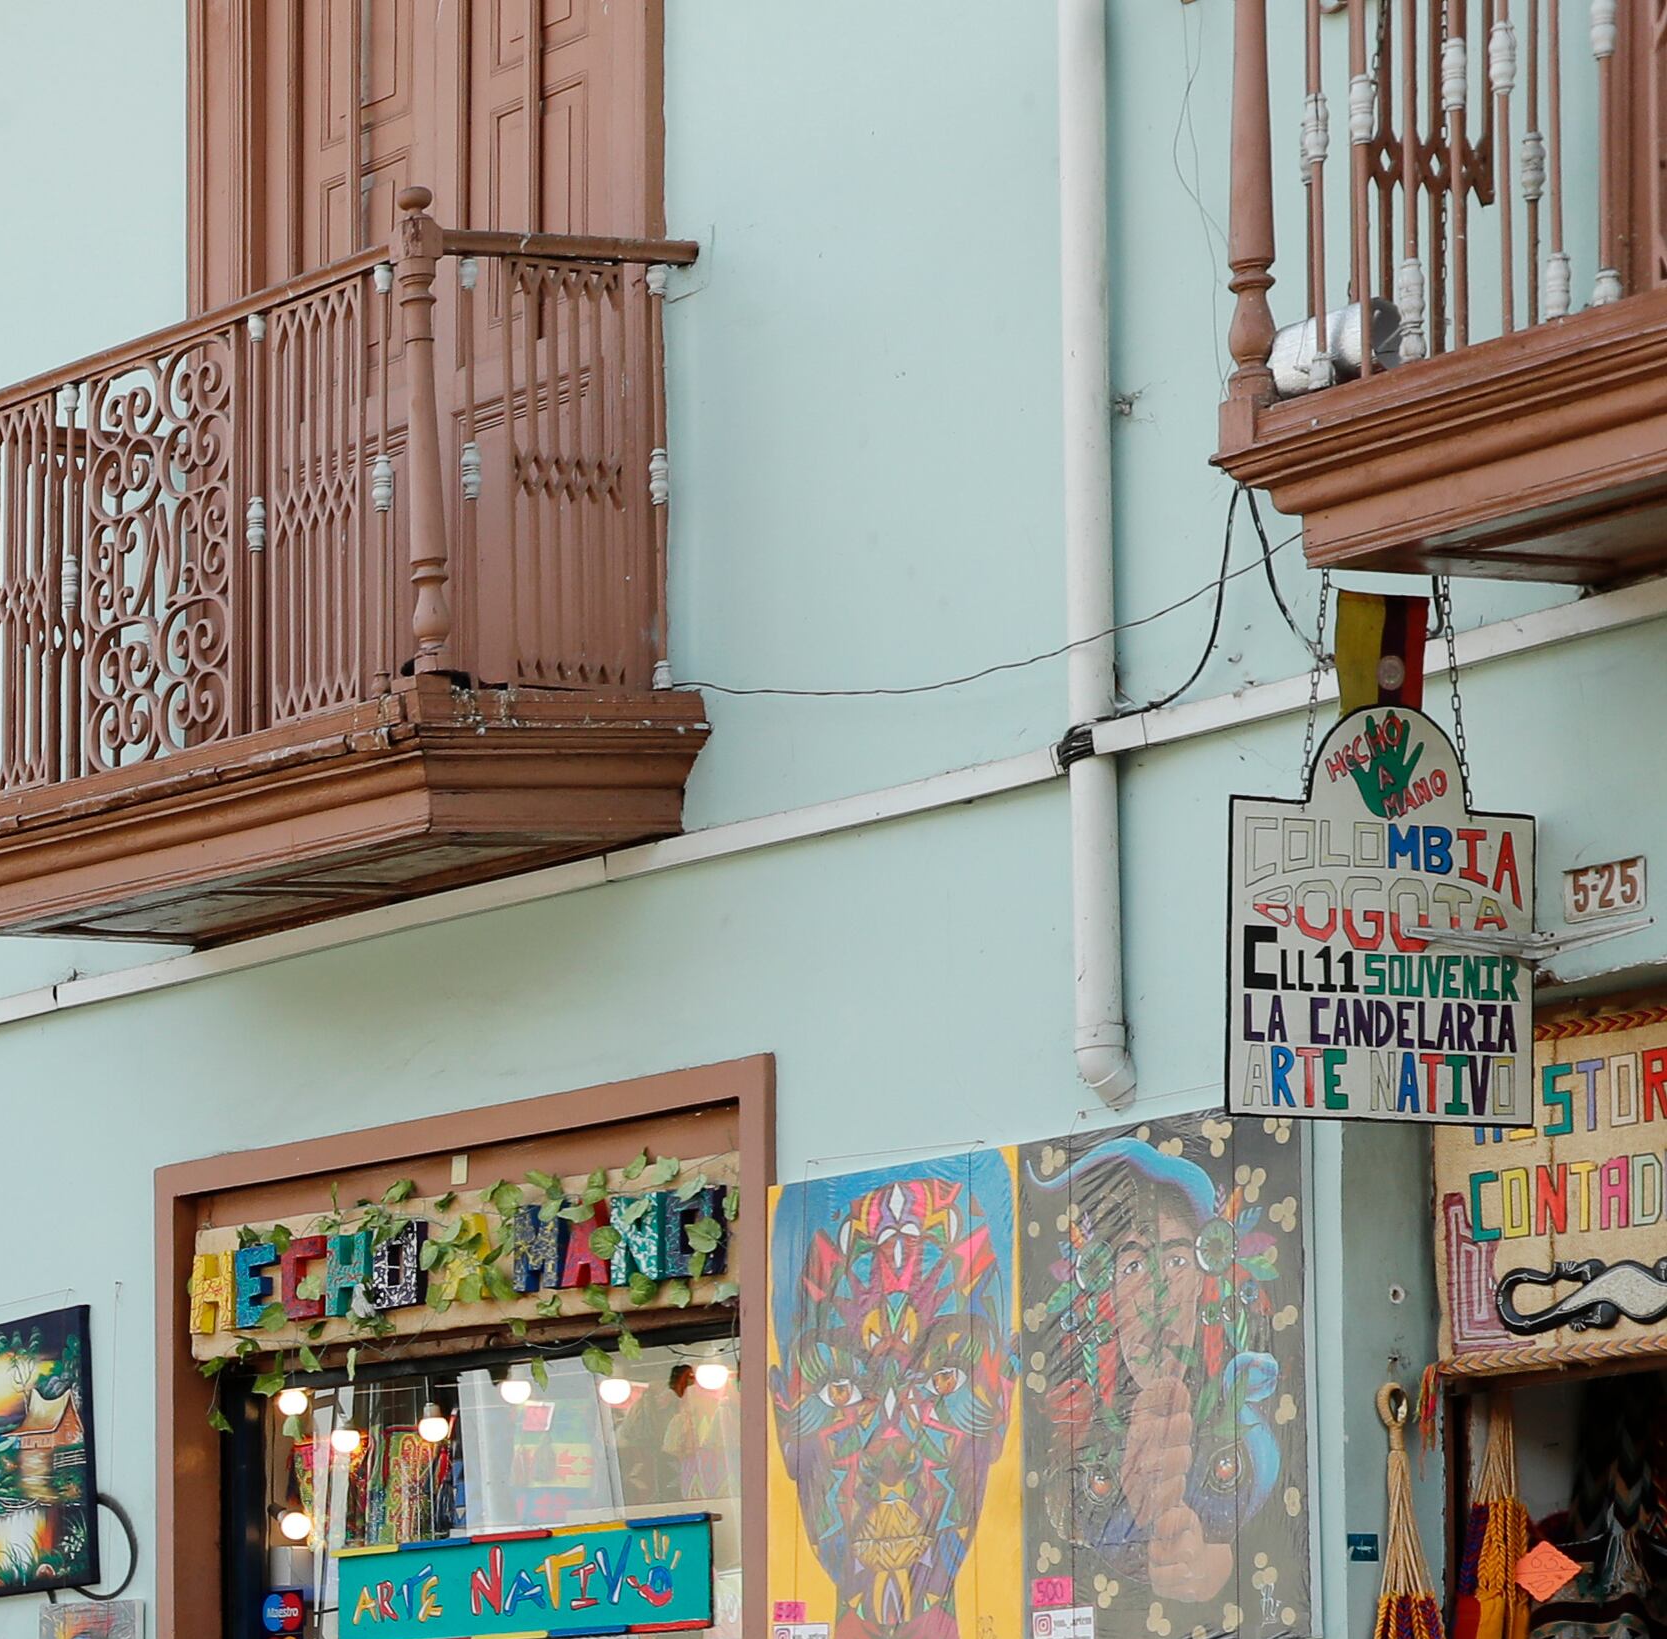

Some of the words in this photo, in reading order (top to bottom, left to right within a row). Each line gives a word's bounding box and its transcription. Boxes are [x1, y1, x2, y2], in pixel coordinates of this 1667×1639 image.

[1382, 768, 1448, 821] MANO
[1244, 816, 1523, 912] COLOMBIA
[1572, 858, 1638, 913] 5-25
[1252, 876, 1509, 953] BOGOTA
[1363, 954, 1521, 1002] SOUVENIR
[1243, 993, 1288, 1042] LA
[1309, 996, 1517, 1052] CANDELARIA
[1242, 1044, 1349, 1110] ARTE
[1370, 1049, 1516, 1115] NATIVO
[1474, 1048, 1667, 1146] STOR
[1469, 1152, 1667, 1244] CONTAD
[190, 1219, 428, 1335] HECHO
[512, 1184, 728, 1292] MANO
[266, 1606, 299, 1618] Maestro
[351, 1563, 443, 1626] ARTE
[470, 1531, 682, 1617] NATIVO
